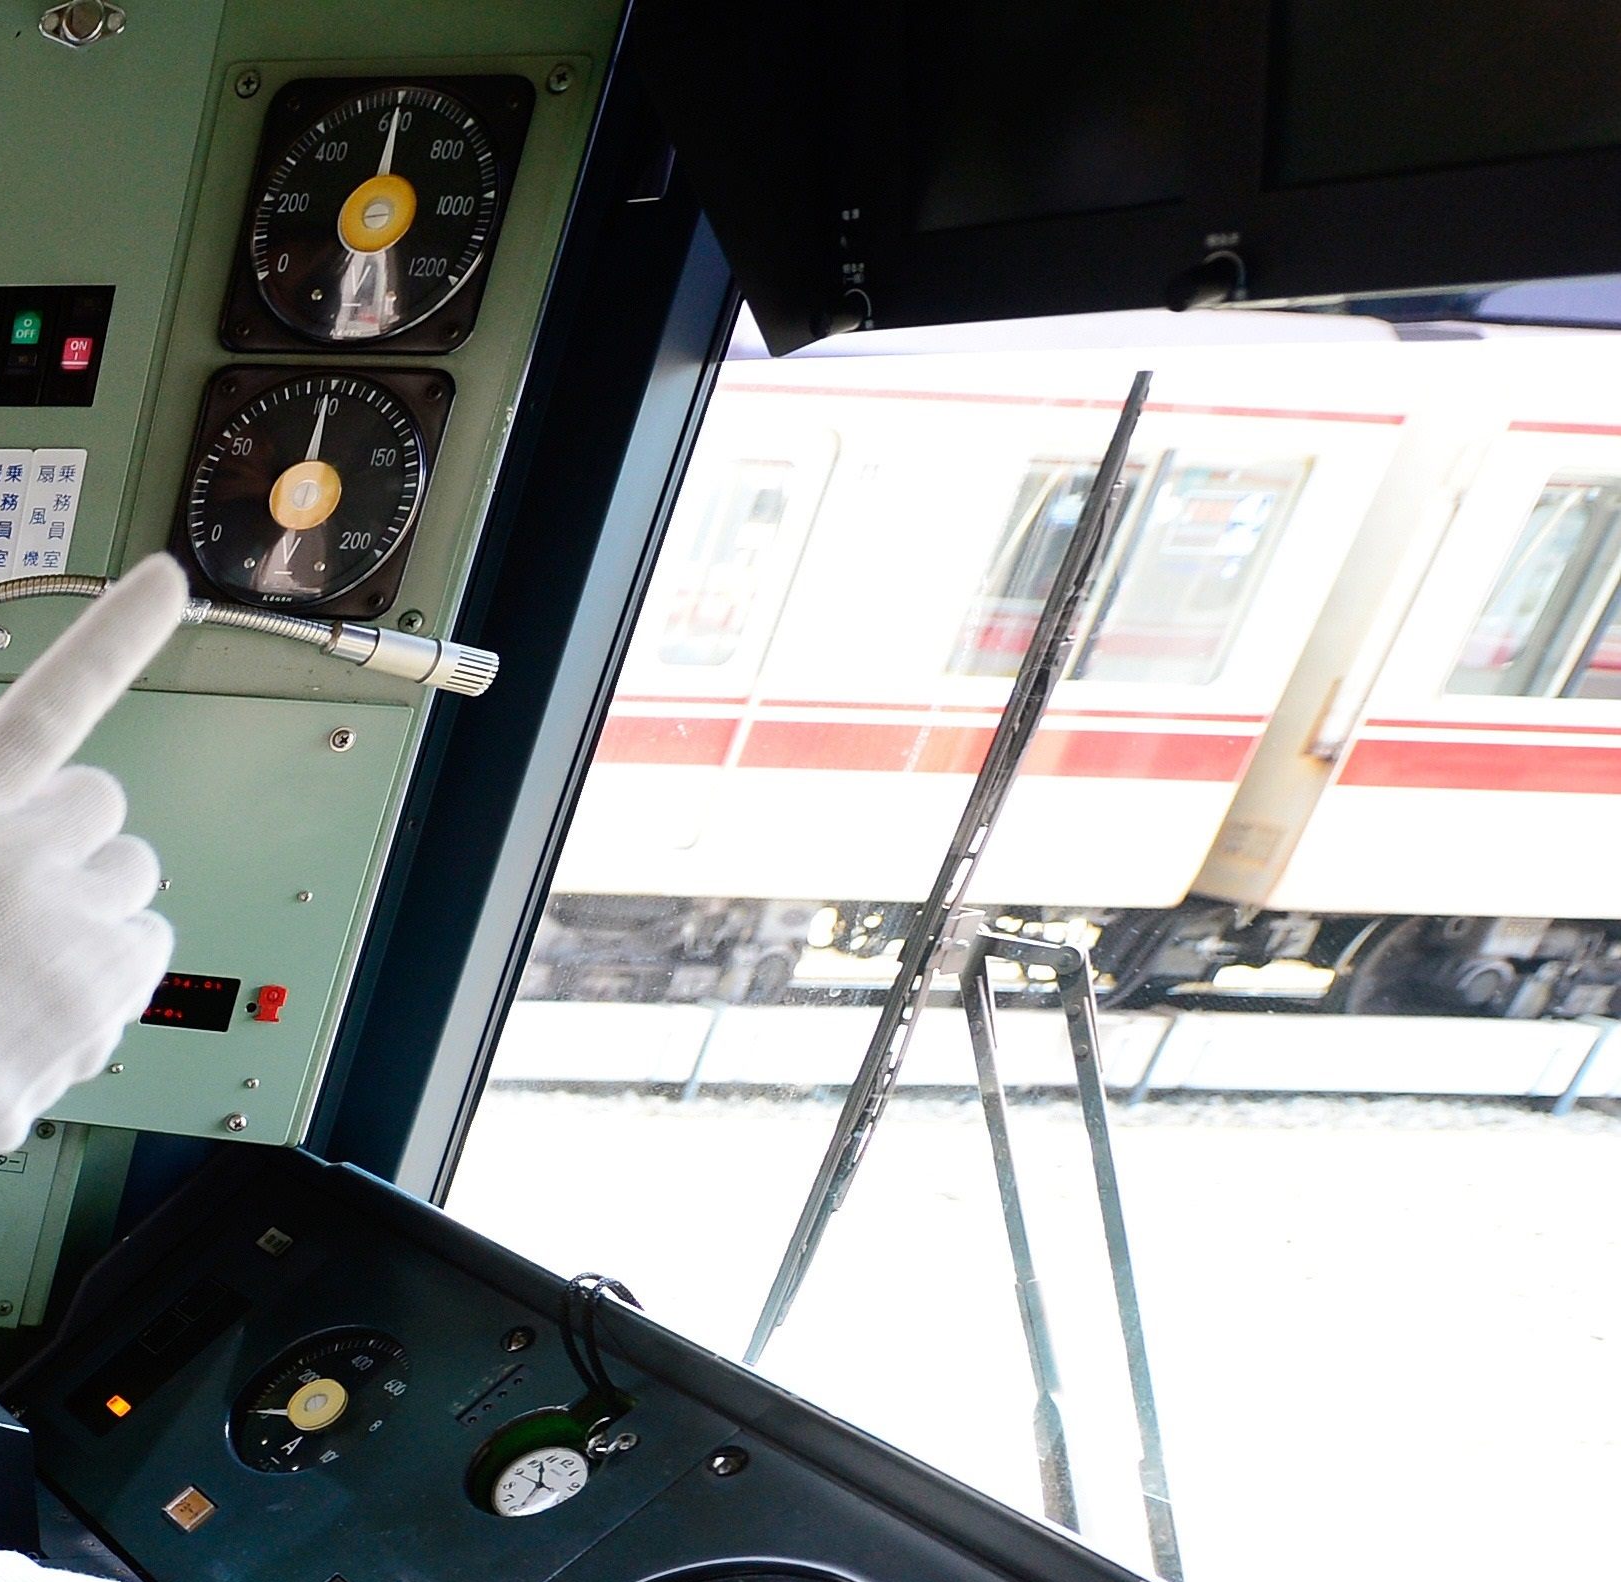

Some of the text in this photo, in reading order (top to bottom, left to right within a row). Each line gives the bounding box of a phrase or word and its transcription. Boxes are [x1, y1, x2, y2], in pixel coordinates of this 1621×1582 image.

[315, 142, 348, 161] 400
[430, 140, 464, 160] 800
[277, 193, 309, 213] 200
[436, 196, 475, 216] 1000
[277, 253, 289, 273] 0
[409, 257, 447, 277] 1200
[15, 329, 37, 340] OFF
[70, 340, 88, 352] ON
[231, 438, 252, 456] 50
[371, 448, 396, 467] 150
[22, 464, 56, 567] 扇風機
[42, 463, 76, 569] 乗務員室
[211, 523, 222, 541] 0
[339, 532, 371, 550] 200
[351, 1354, 374, 1371] 400
[383, 1379, 406, 1397] 600
[281, 1436, 304, 1455] A
